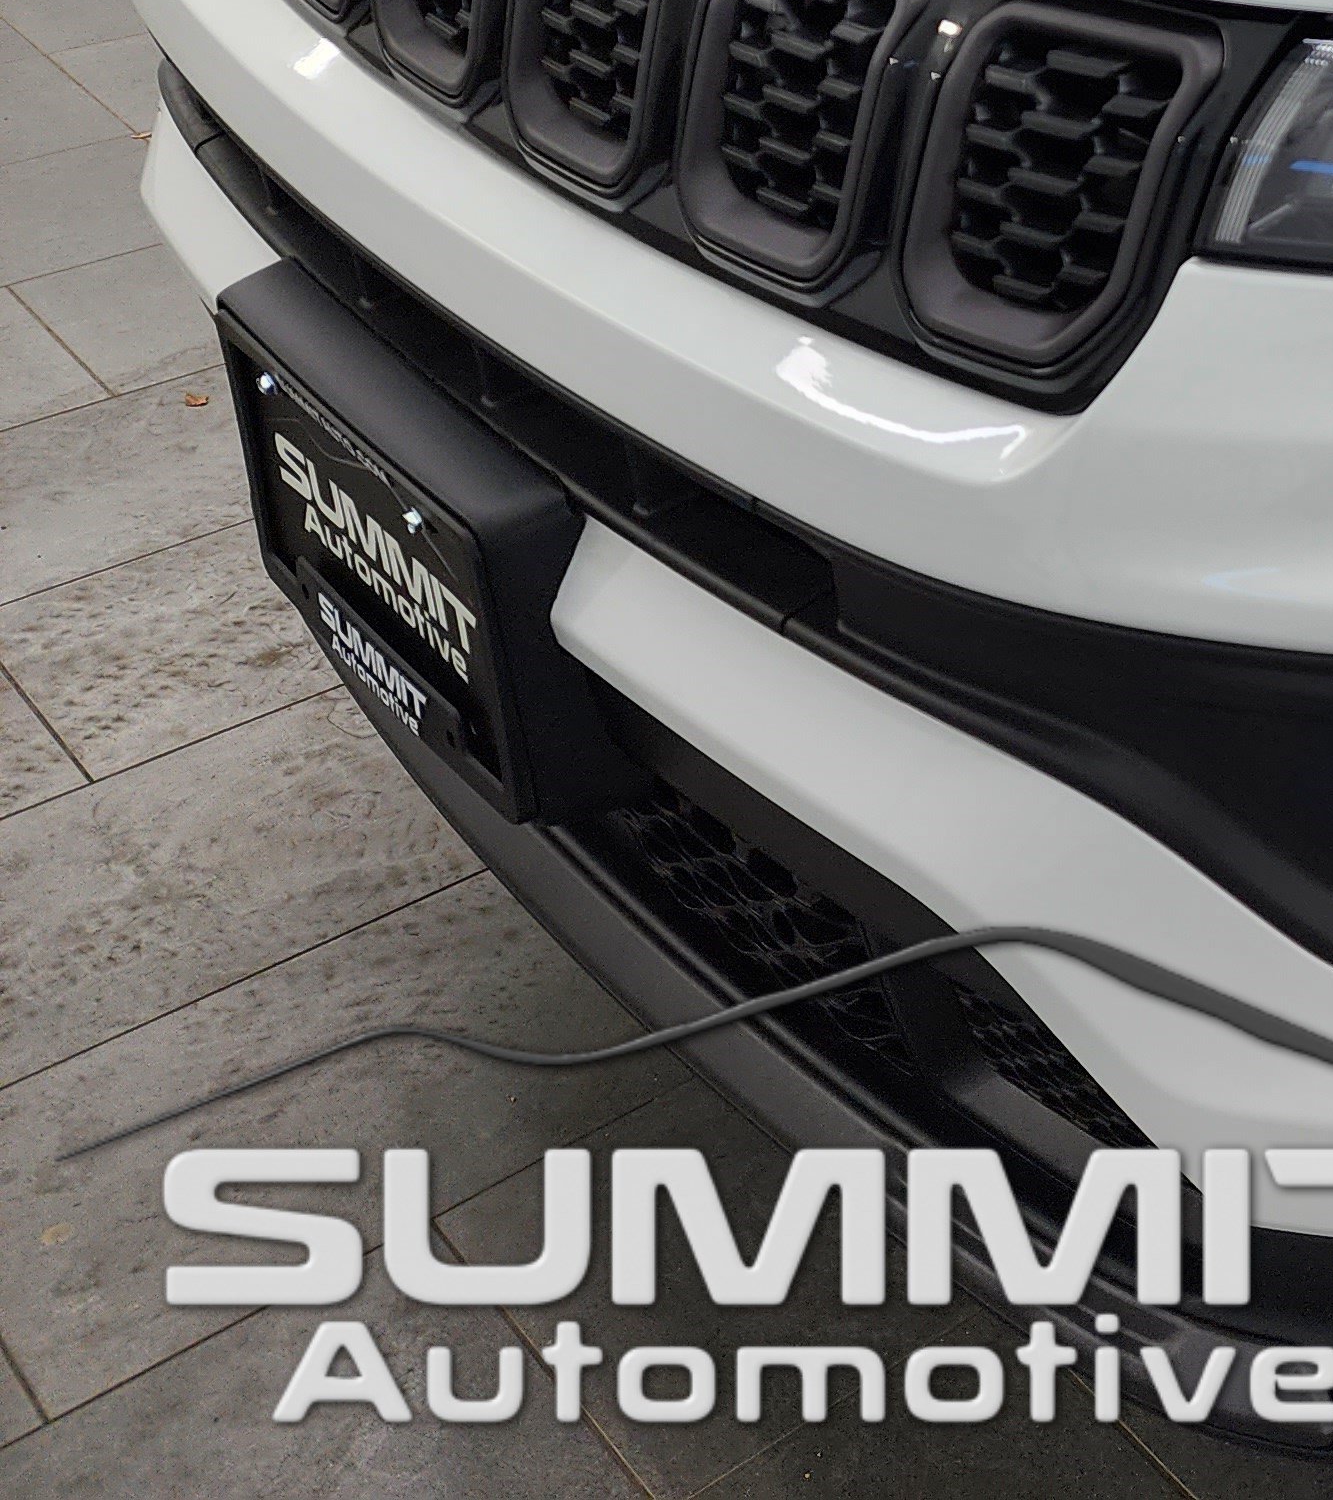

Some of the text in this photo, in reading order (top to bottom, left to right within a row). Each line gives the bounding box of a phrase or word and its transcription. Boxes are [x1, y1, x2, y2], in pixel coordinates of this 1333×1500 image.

[274, 431, 477, 656] SUMMIT
[303, 502, 469, 686] Automotive
[317, 591, 428, 720] SUMMIT
[331, 633, 420, 739] Automotive
